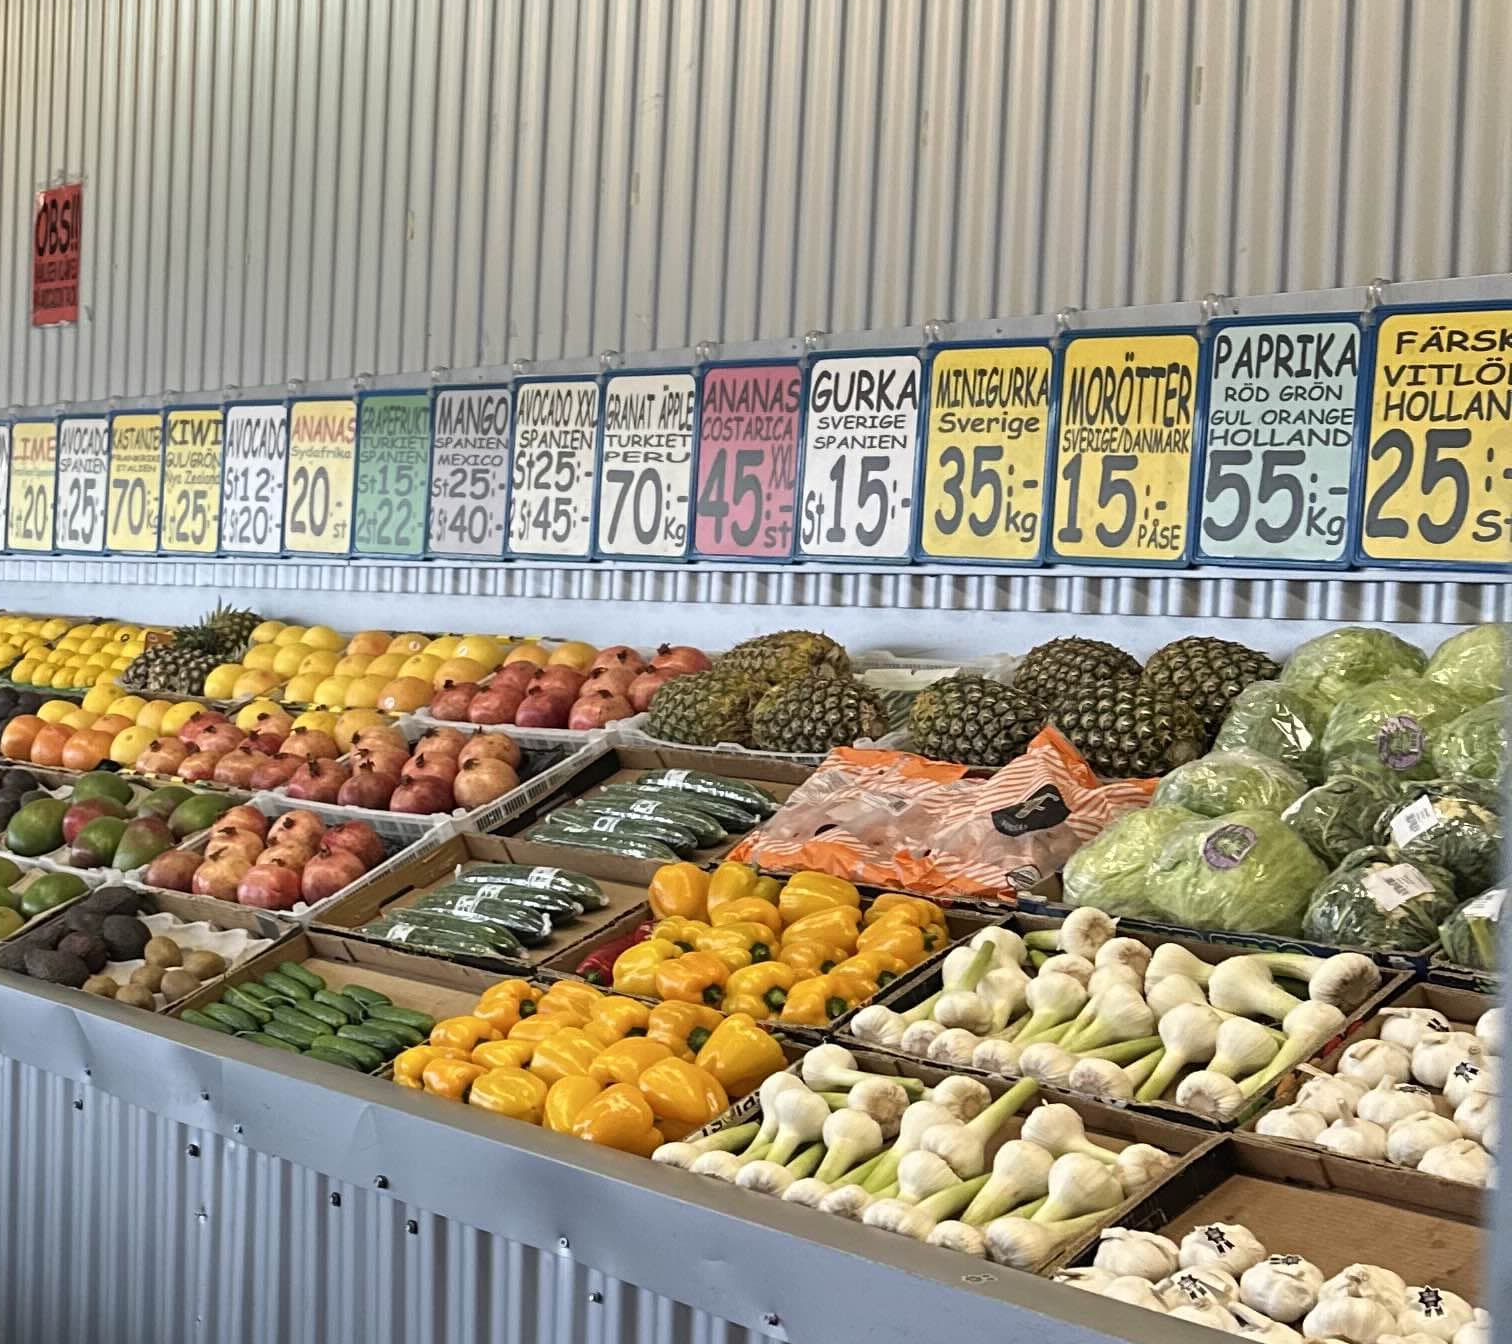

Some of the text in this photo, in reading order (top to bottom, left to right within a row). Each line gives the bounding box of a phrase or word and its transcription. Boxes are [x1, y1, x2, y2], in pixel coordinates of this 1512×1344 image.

[1213, 332, 1358, 380] PAPRIKA
[1384, 357, 1512, 388] VITLÖ
[703, 377, 800, 414] ANANAS
[812, 369, 918, 414] GURKA
[936, 366, 1049, 410] MINIGURKA
[1066, 352, 1192, 426] MORÖTTER
[1224, 380, 1343, 403] RÖD GRÖN
[438, 396, 508, 436] MANGO
[517, 389, 573, 428] AVOCADO
[606, 393, 655, 432] GRANAT
[817, 414, 906, 430] SVERIGE
[1210, 408, 1354, 426] GUL ORANGE
[167, 419, 223, 446] KIWI
[227, 417, 287, 460] AVOCADO
[292, 416, 356, 444] ANANAS
[519, 429, 593, 450] SPANIEN
[938, 412, 1040, 440] Sverige
[1209, 428, 1353, 448] HOLLAND
[362, 436, 427, 450] TURKIET
[435, 436, 509, 450] SPANIEN
[605, 434, 692, 448] TURKIET
[813, 434, 907, 450] SPANIEN
[1062, 427, 1189, 454] SVERIGE/DANMARK
[359, 450, 428, 464] SPANIEN
[438, 454, 503, 467] MEXICO
[604, 451, 690, 463] PERU
[1203, 449, 1349, 544] 55:-
[1005, 501, 1038, 544] kg
[1306, 507, 1347, 545] Kg
[1137, 523, 1181, 551] PÅSE
